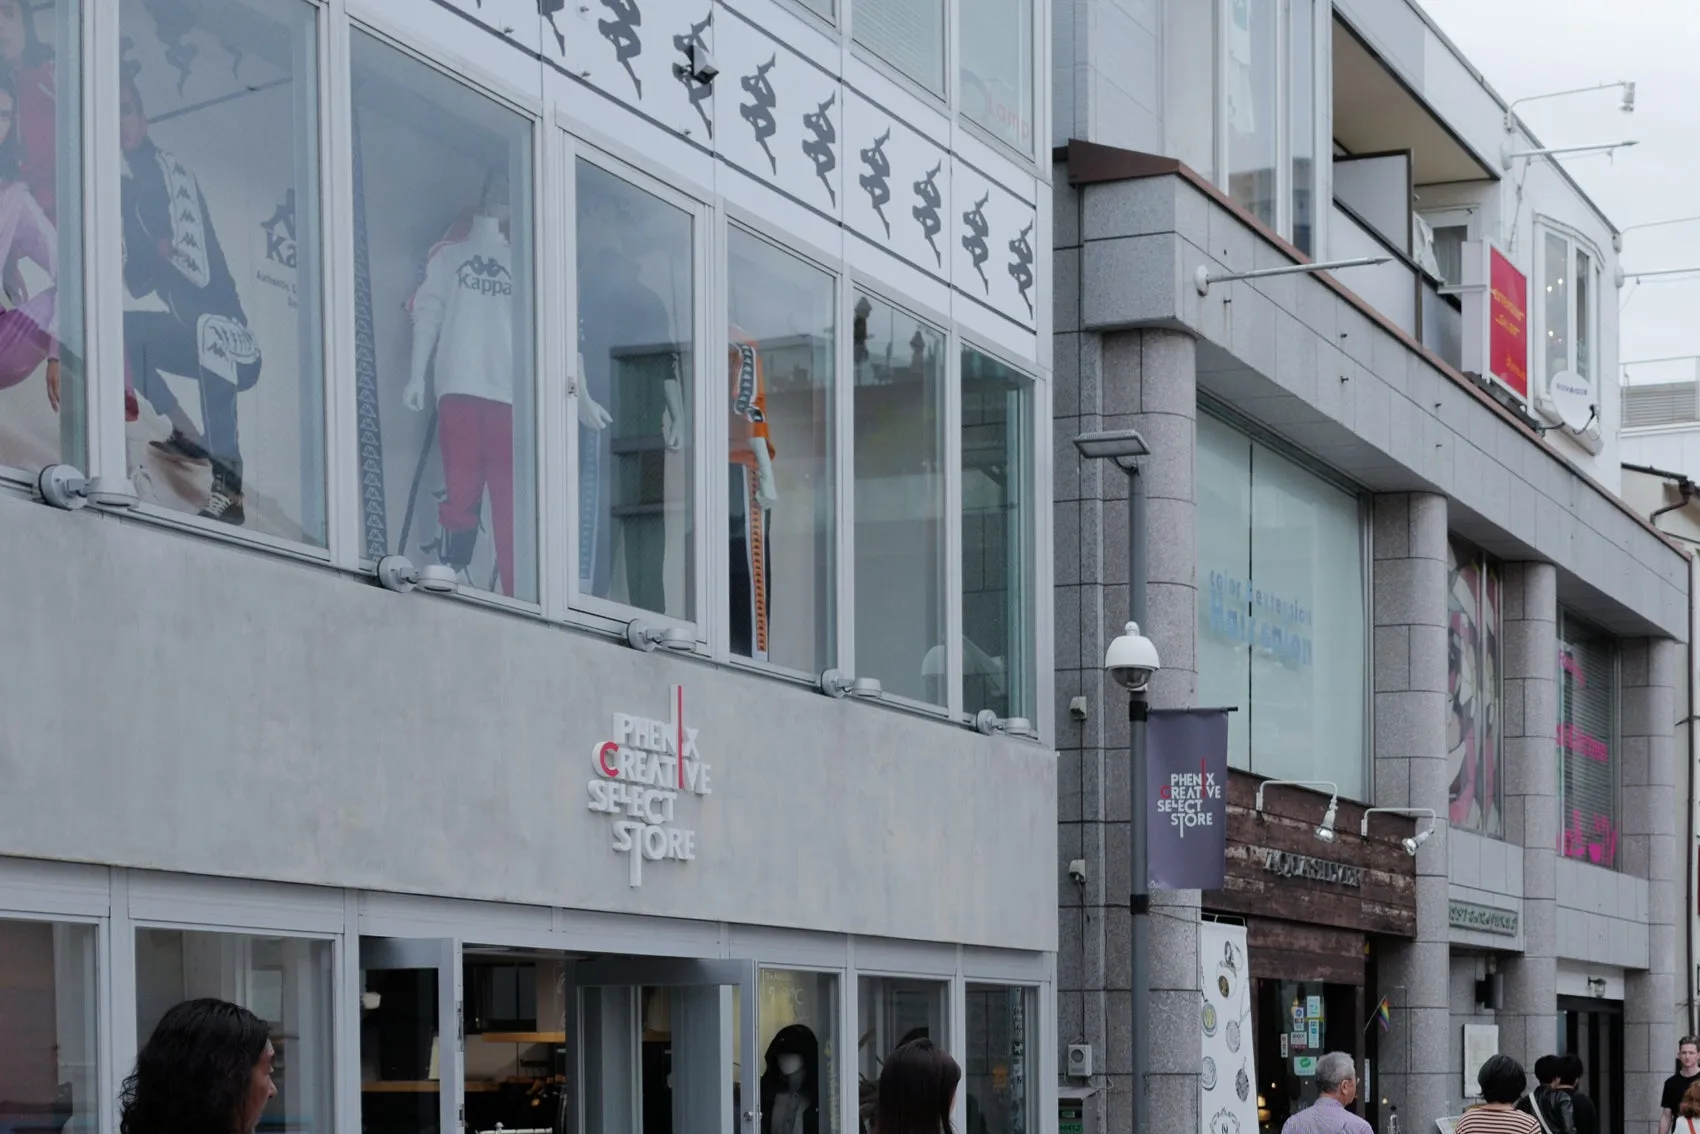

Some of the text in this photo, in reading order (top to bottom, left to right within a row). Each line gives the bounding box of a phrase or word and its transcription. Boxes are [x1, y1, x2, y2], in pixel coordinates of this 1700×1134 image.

[459, 273, 512, 296] Kappa
[591, 740, 712, 794] CREATIVE
[587, 779, 678, 825] SELECT
[1160, 784, 1221, 800] CREATIVE
[1157, 799, 1203, 814] SELECT
[1171, 812, 1213, 838] STORE
[612, 820, 696, 887] STORE
